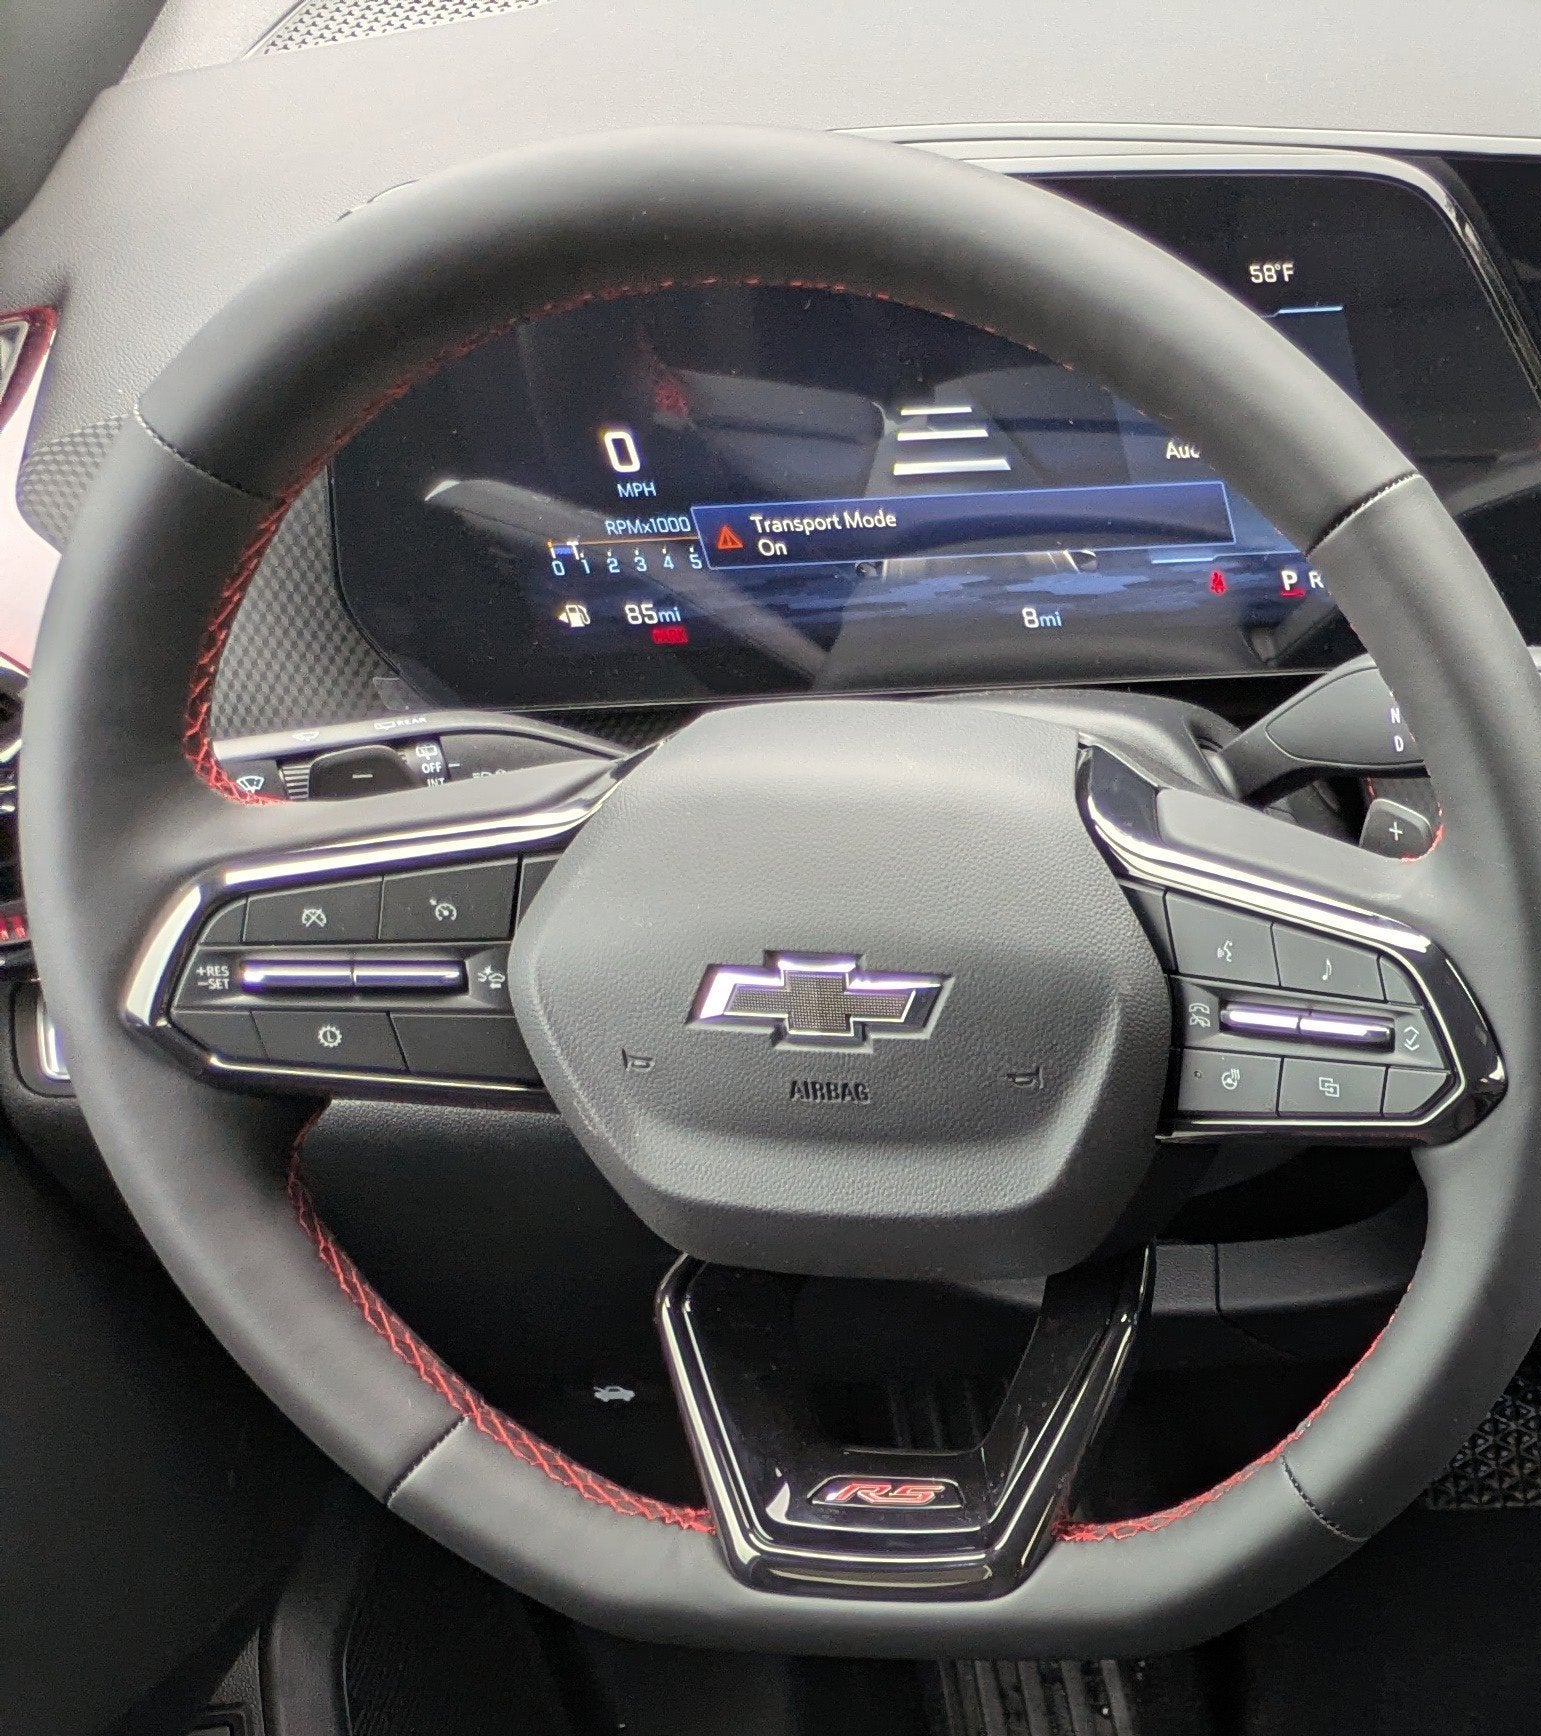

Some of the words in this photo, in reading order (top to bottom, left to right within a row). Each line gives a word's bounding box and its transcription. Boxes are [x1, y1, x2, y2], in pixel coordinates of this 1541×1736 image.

[1249, 262, 1295, 284] 58°F
[603, 430, 641, 474] 0
[617, 481, 657, 499] MPH
[604, 516, 691, 536] RPMx1000
[749, 513, 842, 536] Transport
[843, 509, 898, 529] Mode
[758, 538, 788, 557] On
[551, 560, 565, 576] 0
[580, 559, 591, 574] 1
[607, 557, 621, 573] 2
[634, 556, 648, 572] 3
[663, 554, 675, 570] 4
[689, 553, 703, 569] 5
[1281, 569, 1298, 591] P
[1308, 570, 1325, 589] R
[1390, 707, 1401, 724] N
[1393, 734, 1404, 752] D
[421, 762, 442, 774] OFF
[789, 1079, 870, 1103] AIRBAG
[824, 1482, 945, 1504] RS
